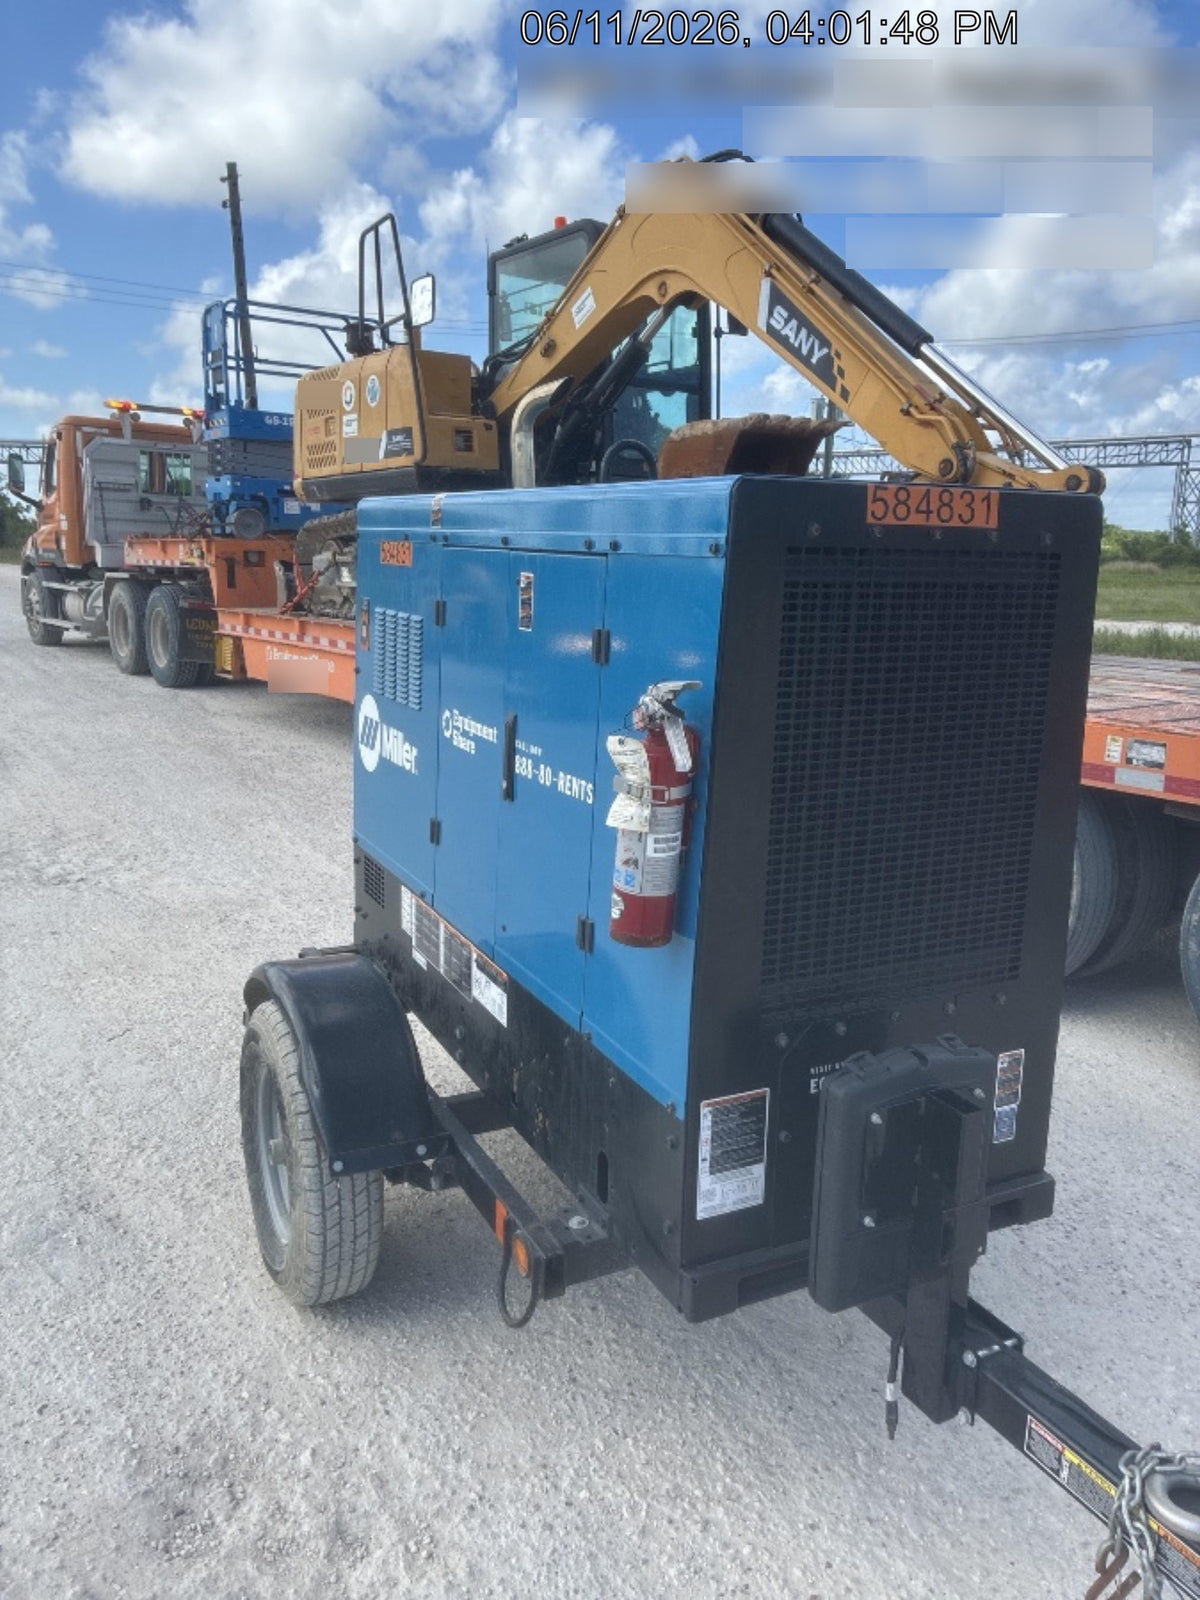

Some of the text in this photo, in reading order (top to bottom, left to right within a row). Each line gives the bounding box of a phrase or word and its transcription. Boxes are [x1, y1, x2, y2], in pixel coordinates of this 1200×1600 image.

[769, 305, 829, 365] SANY
[870, 486, 992, 525] 584831
[453, 709, 497, 744] Equipment
[453, 729, 476, 755] Share
[381, 723, 418, 774] Miller
